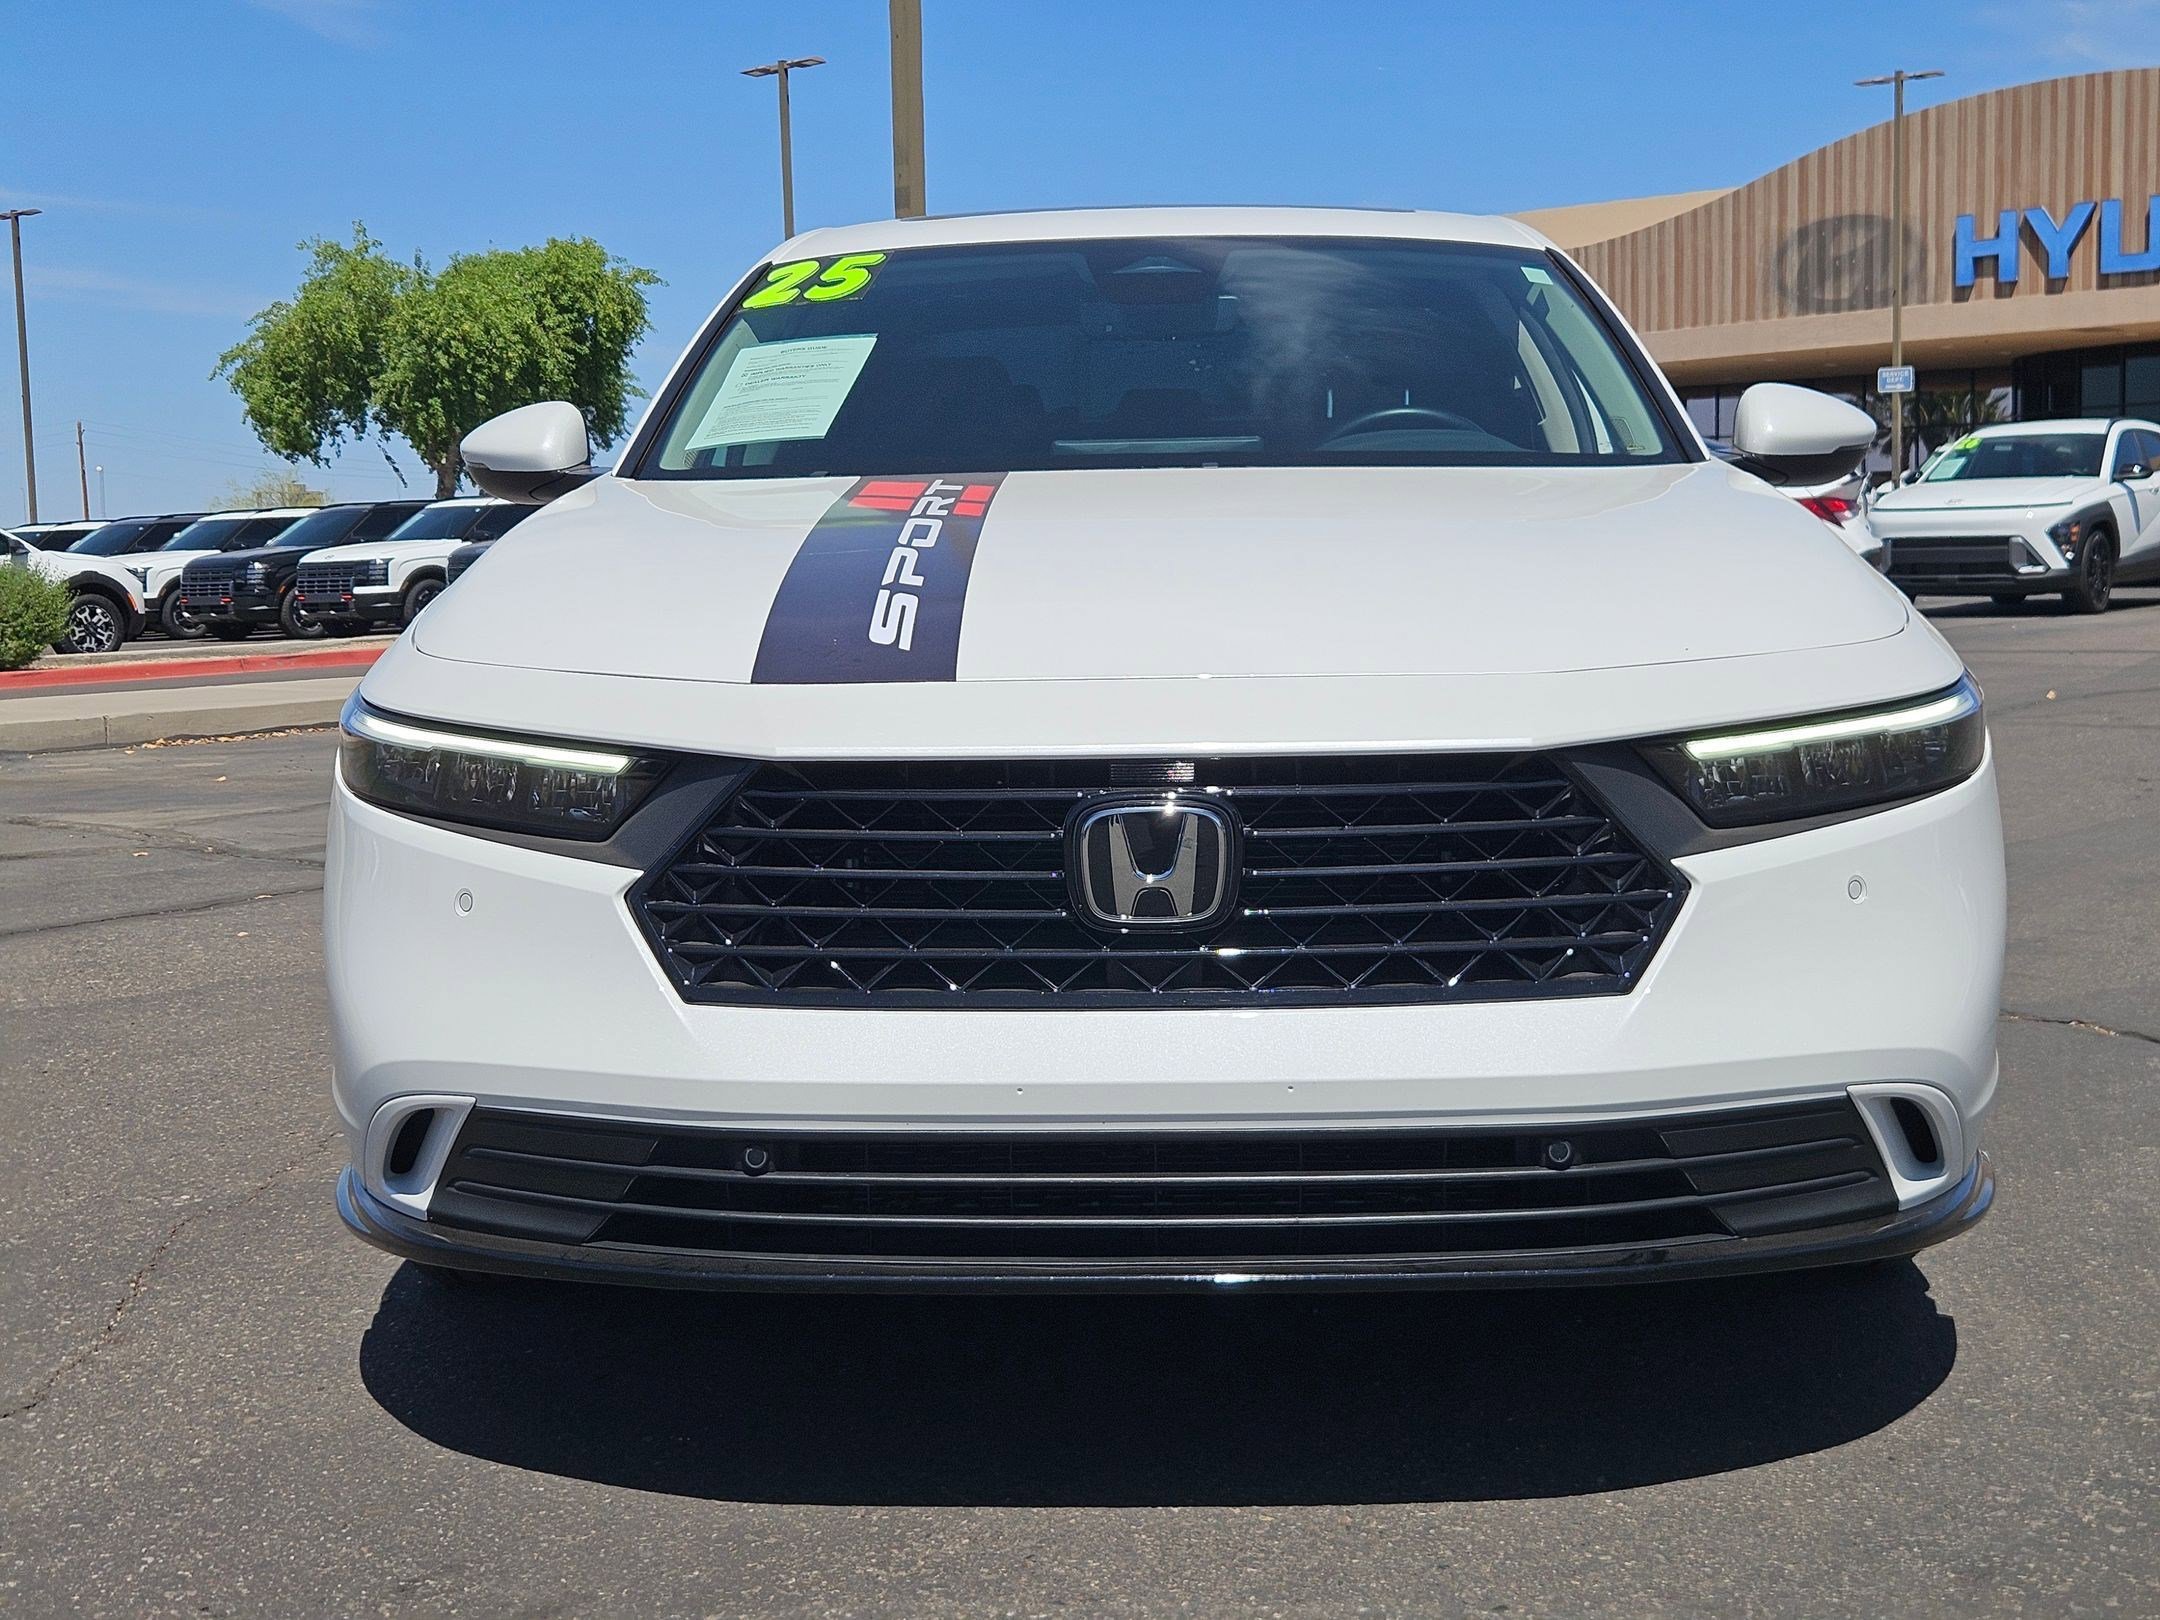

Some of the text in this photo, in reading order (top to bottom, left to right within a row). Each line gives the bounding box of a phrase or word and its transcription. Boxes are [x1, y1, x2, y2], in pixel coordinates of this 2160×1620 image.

[742, 252, 887, 309] 25
[1955, 194, 2160, 287] HYU
[868, 479, 964, 651] SPORT
